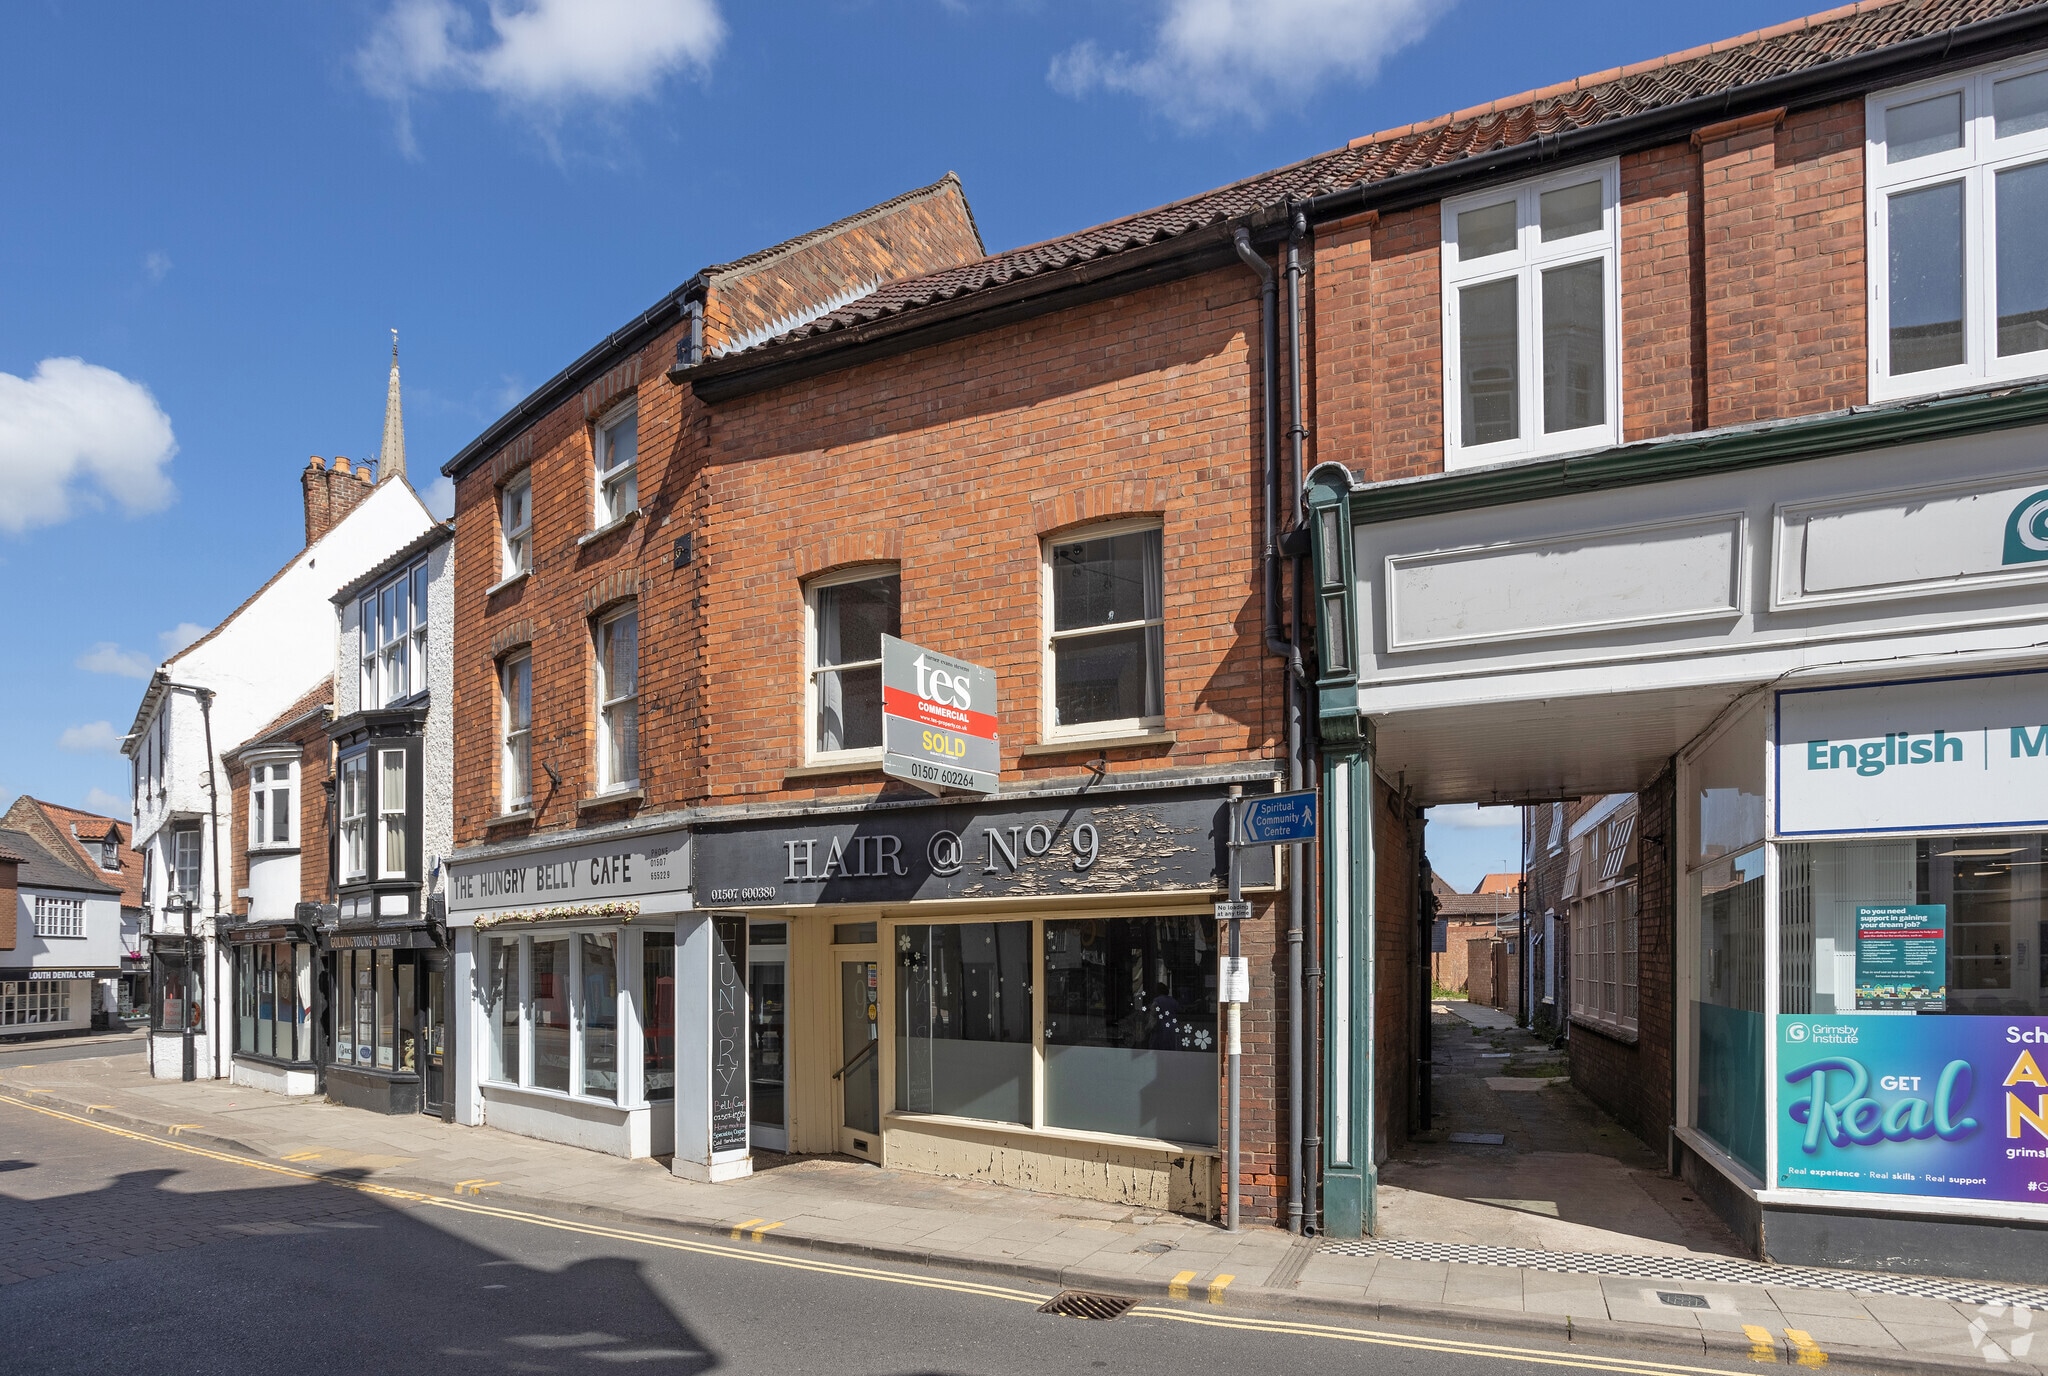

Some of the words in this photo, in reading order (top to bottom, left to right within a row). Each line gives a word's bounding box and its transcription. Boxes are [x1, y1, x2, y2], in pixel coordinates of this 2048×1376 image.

[912, 653, 971, 710] tes
[918, 702, 970, 722] COMMERCIAL
[922, 730, 966, 758] SOLD
[1808, 730, 1963, 776] English
[912, 763, 938, 781] 01507
[942, 770, 974, 788] 602264
[1261, 800, 1294, 814] Spiritual
[1256, 813, 1300, 826] Community
[1264, 826, 1290, 837] Centre
[650, 846, 669, 857] PHONE
[784, 834, 908, 880] HAIR
[926, 829, 964, 874] @
[1072, 824, 1100, 869] 9
[650, 858, 666, 867] 01507
[454, 875, 474, 900] THE
[480, 868, 526, 897] HUNGRY
[536, 860, 578, 891] BELLY
[590, 854, 632, 886] CAFE
[712, 888, 739, 900] 01507
[742, 886, 776, 900] 600380
[29, 972, 51, 980] LOUTH
[52, 971, 77, 979] DENTAL
[78, 970, 95, 978] CARE
[716, 922, 740, 1097] HUNGRY
[1812, 1024, 1859, 1036] Grimsby
[1812, 1034, 1859, 1044] Institute
[1880, 1076, 1921, 1091] GET
[1784, 1056, 1978, 1154] Real
[1788, 1167, 1807, 1175] Real
[1809, 1170, 1860, 1178] experience
[1892, 1172, 1916, 1180] skills
[1925, 1174, 1945, 1182] Real
[1949, 1176, 1986, 1185] support
